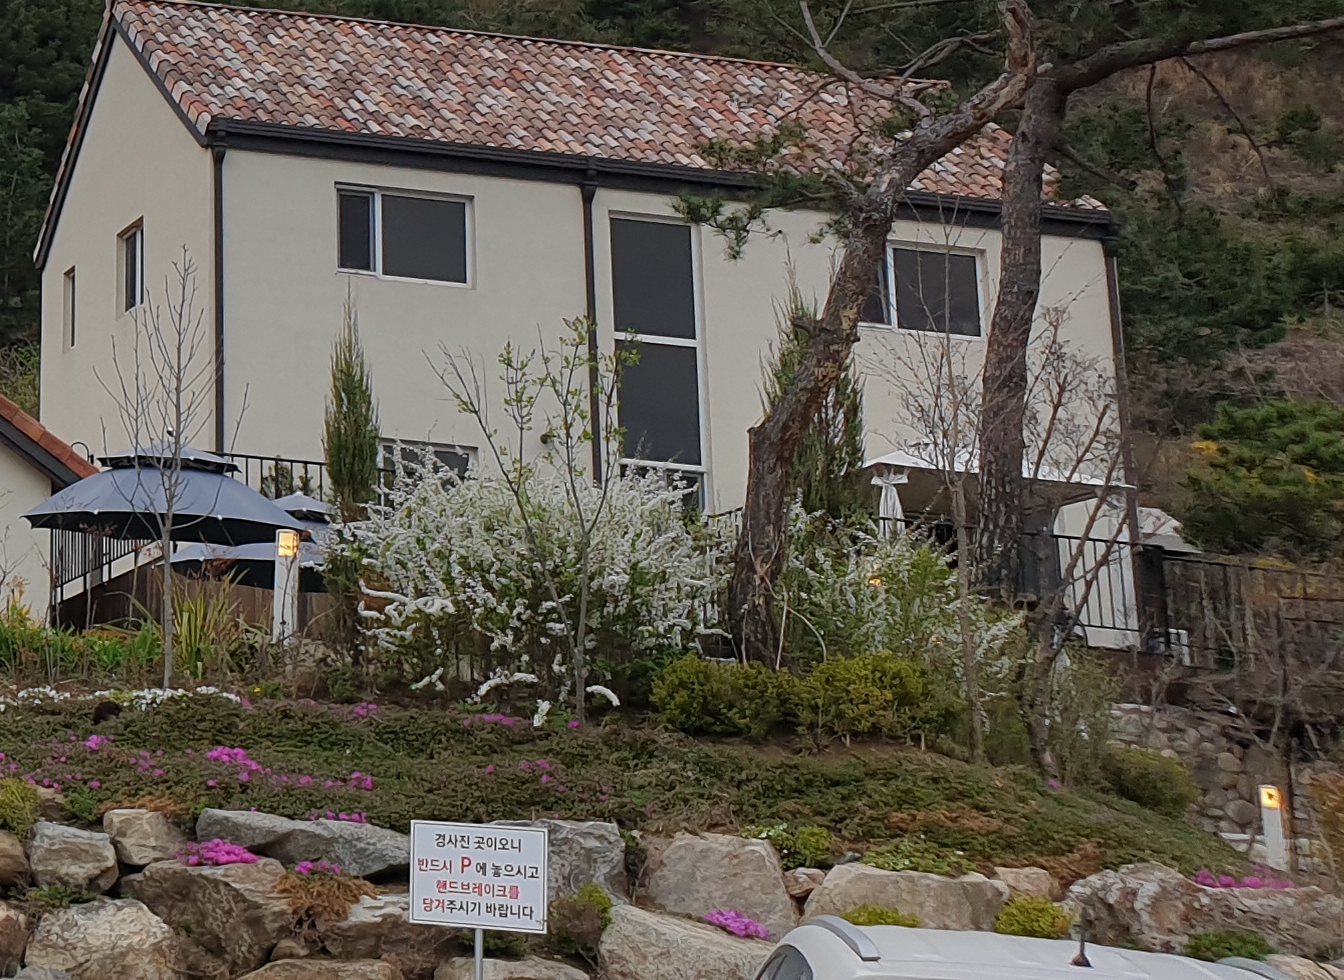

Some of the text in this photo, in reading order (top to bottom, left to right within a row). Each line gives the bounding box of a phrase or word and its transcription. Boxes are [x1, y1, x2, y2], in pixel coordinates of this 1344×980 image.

[434, 833, 522, 853] 경사진 곳이오니
[417, 858, 453, 875] 반드시
[460, 856, 472, 874] P
[490, 863, 540, 880] 놓으시고
[435, 879, 520, 900] 핸드브레이크를
[422, 897, 534, 920] 당겨주시기 바랍니다
